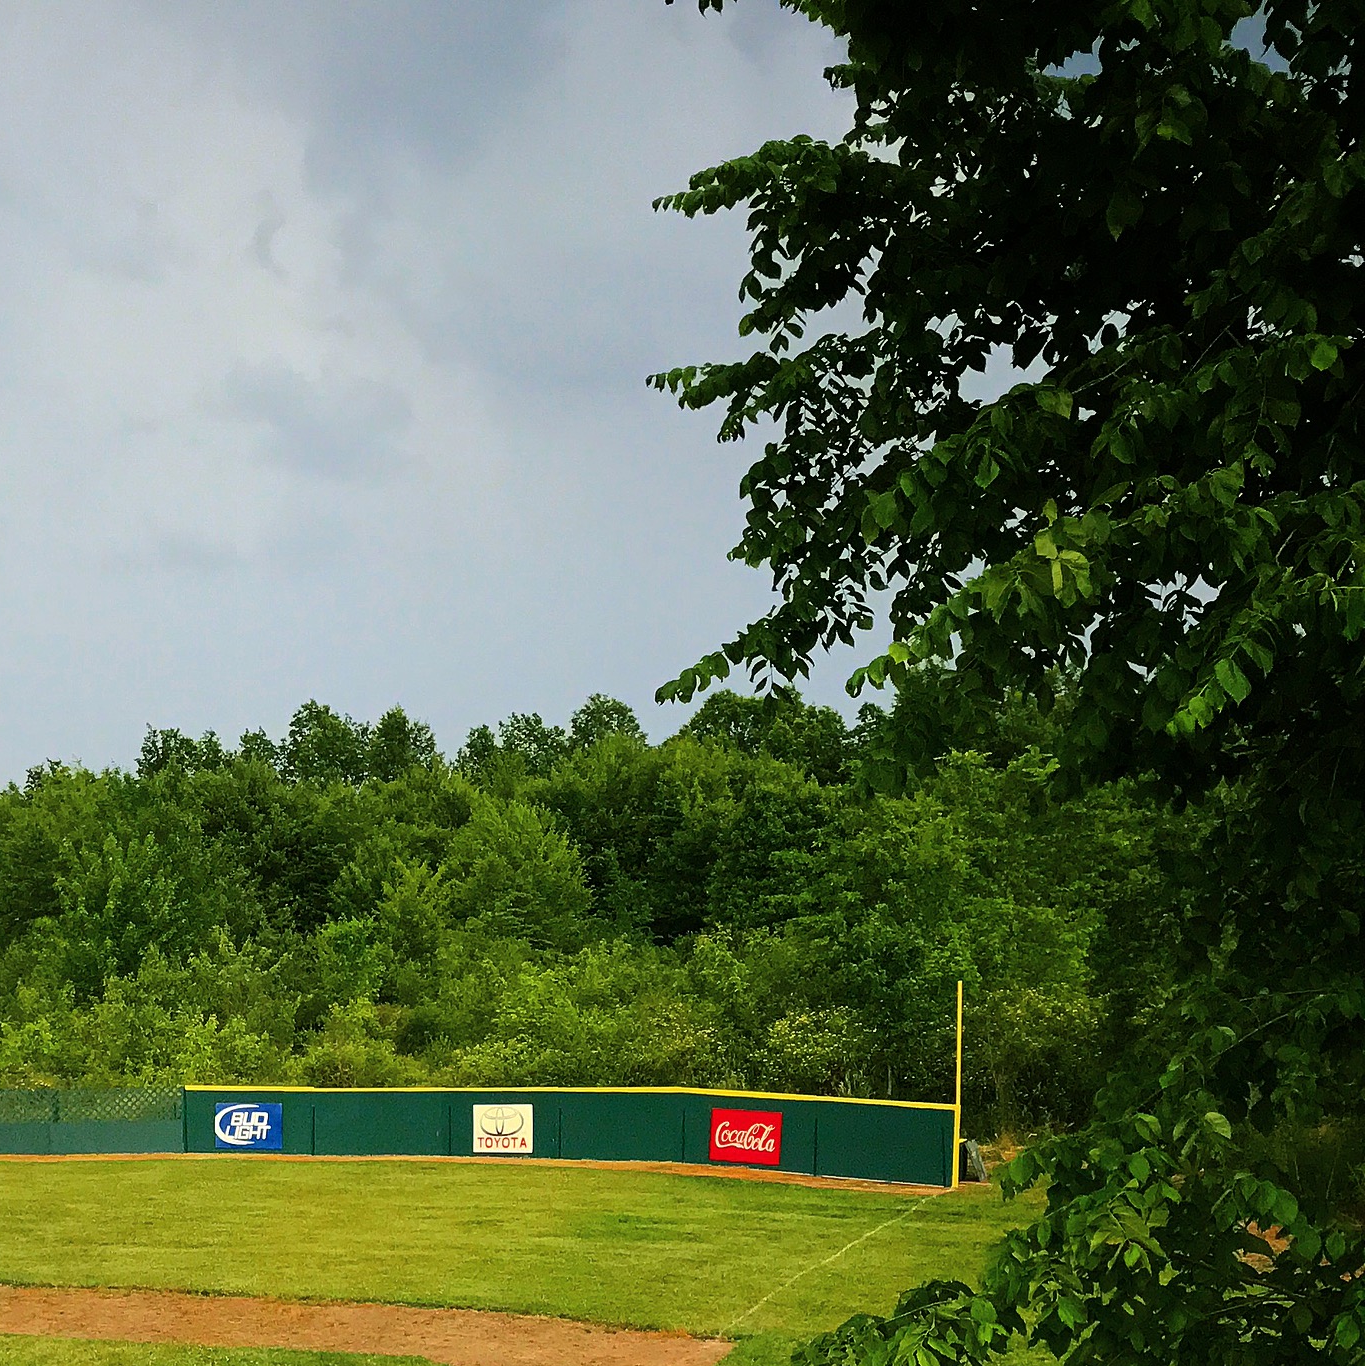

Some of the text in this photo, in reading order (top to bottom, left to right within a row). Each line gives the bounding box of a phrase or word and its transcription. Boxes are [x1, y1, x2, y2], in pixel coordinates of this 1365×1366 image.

[230, 1112, 269, 1127] BUD
[225, 1125, 272, 1140] LIGHT
[477, 1137, 528, 1149] TOYOTA
